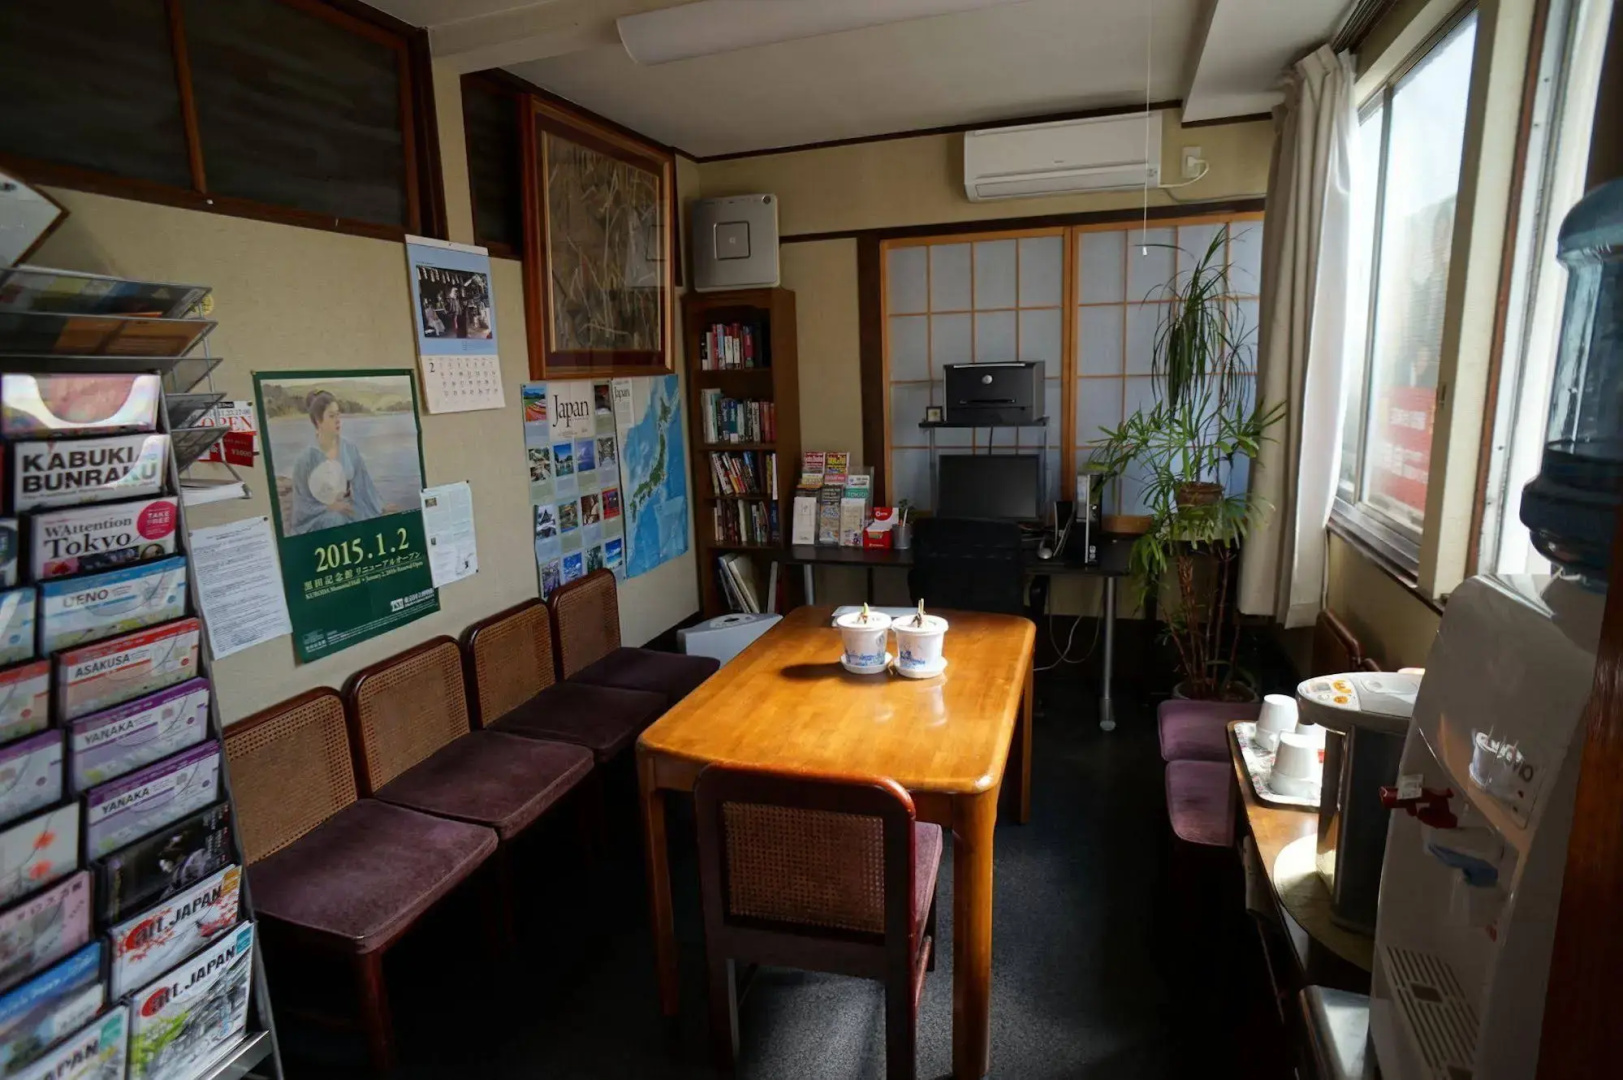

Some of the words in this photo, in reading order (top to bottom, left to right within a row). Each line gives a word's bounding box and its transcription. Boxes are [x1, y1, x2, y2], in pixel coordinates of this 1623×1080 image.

[428, 362, 436, 373] 2
[613, 386, 630, 402] Japan
[552, 394, 589, 428] Japan
[23, 447, 133, 473] KABUKI
[23, 462, 157, 493] BUNRAKU
[45, 518, 131, 537] WAttention
[43, 533, 131, 559] Tokyo
[314, 528, 409, 572] 2015.1.2
[63, 589, 108, 608] UENO
[75, 654, 130, 678] ASAKUSA
[85, 720, 134, 745] YANAKA
[102, 788, 150, 814] YANAKA
